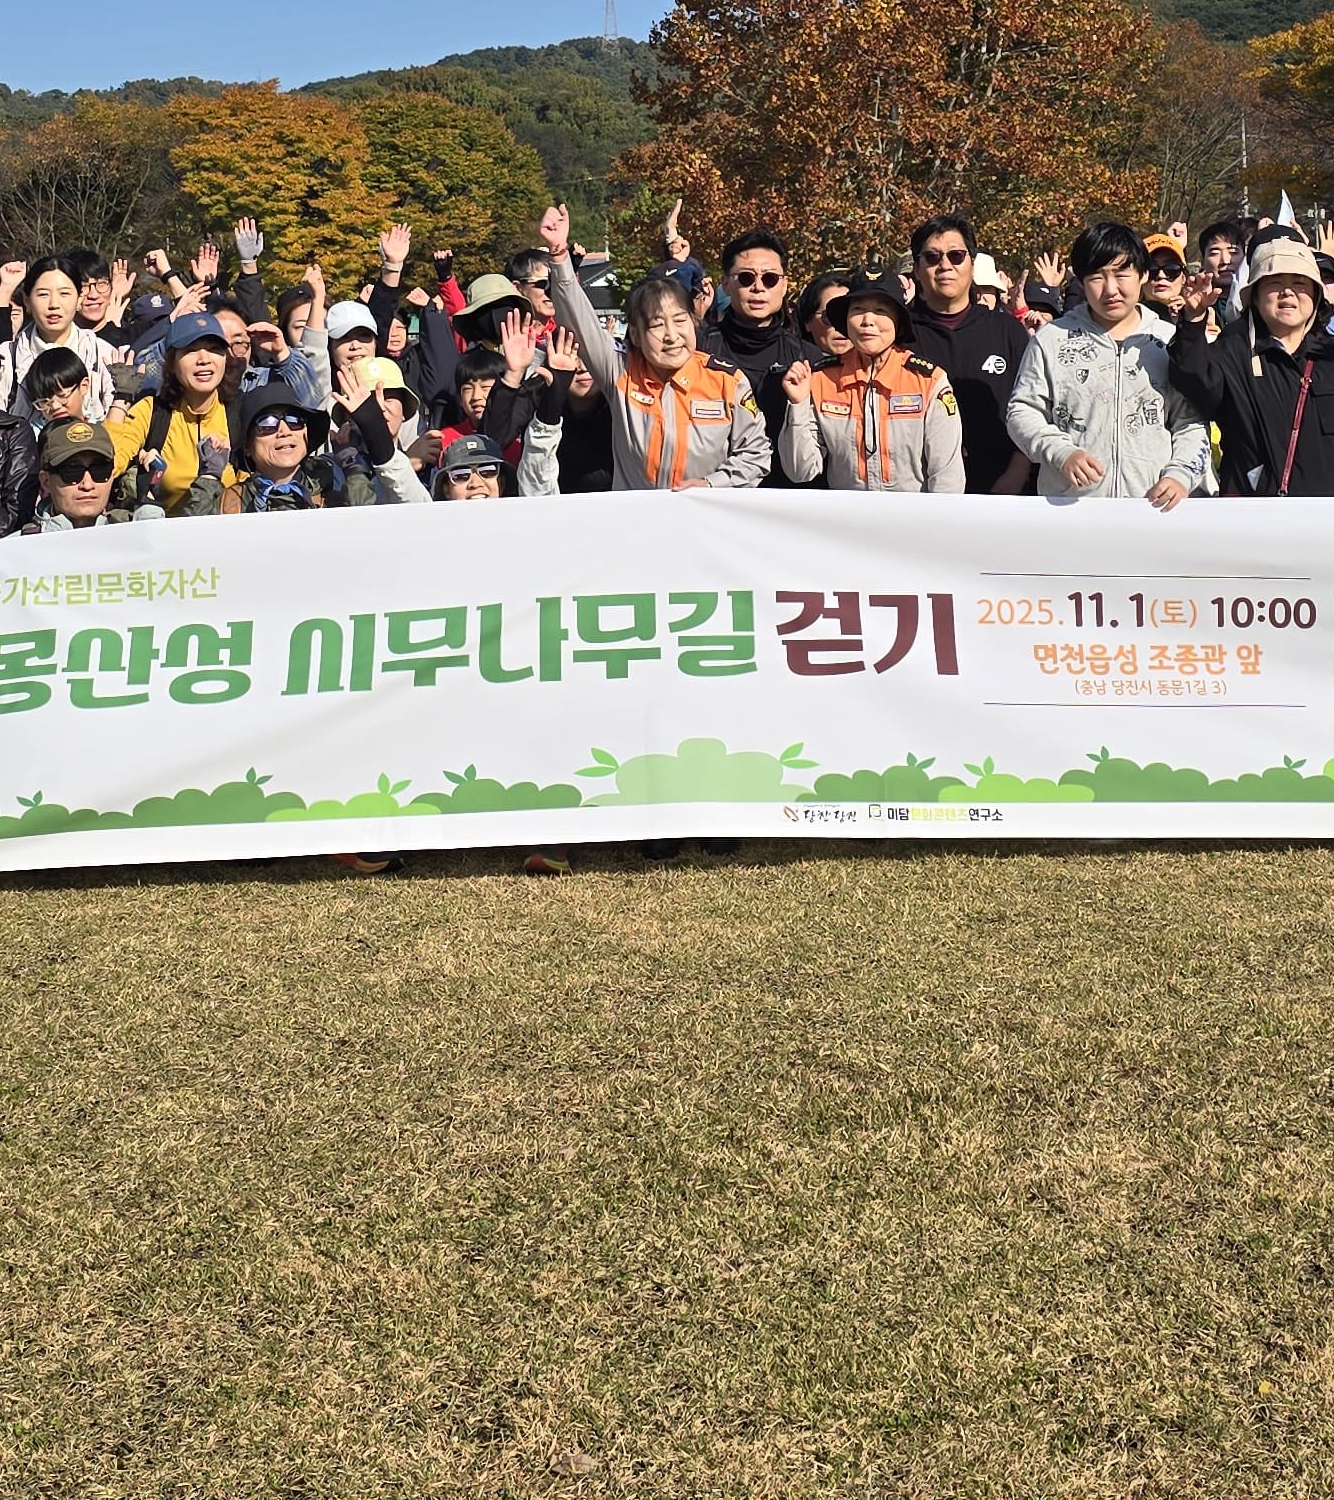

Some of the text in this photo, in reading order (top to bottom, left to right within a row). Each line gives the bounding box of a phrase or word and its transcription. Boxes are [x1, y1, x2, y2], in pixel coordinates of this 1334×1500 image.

[1210, 596, 1317, 630] 10:00
[280, 590, 759, 696] 시무나무길
[775, 590, 960, 676] 걷기
[1033, 643, 1263, 676] 면천읍성 조종관 앞
[1074, 679, 1228, 697] (충남 당진시 동문1길 3)
